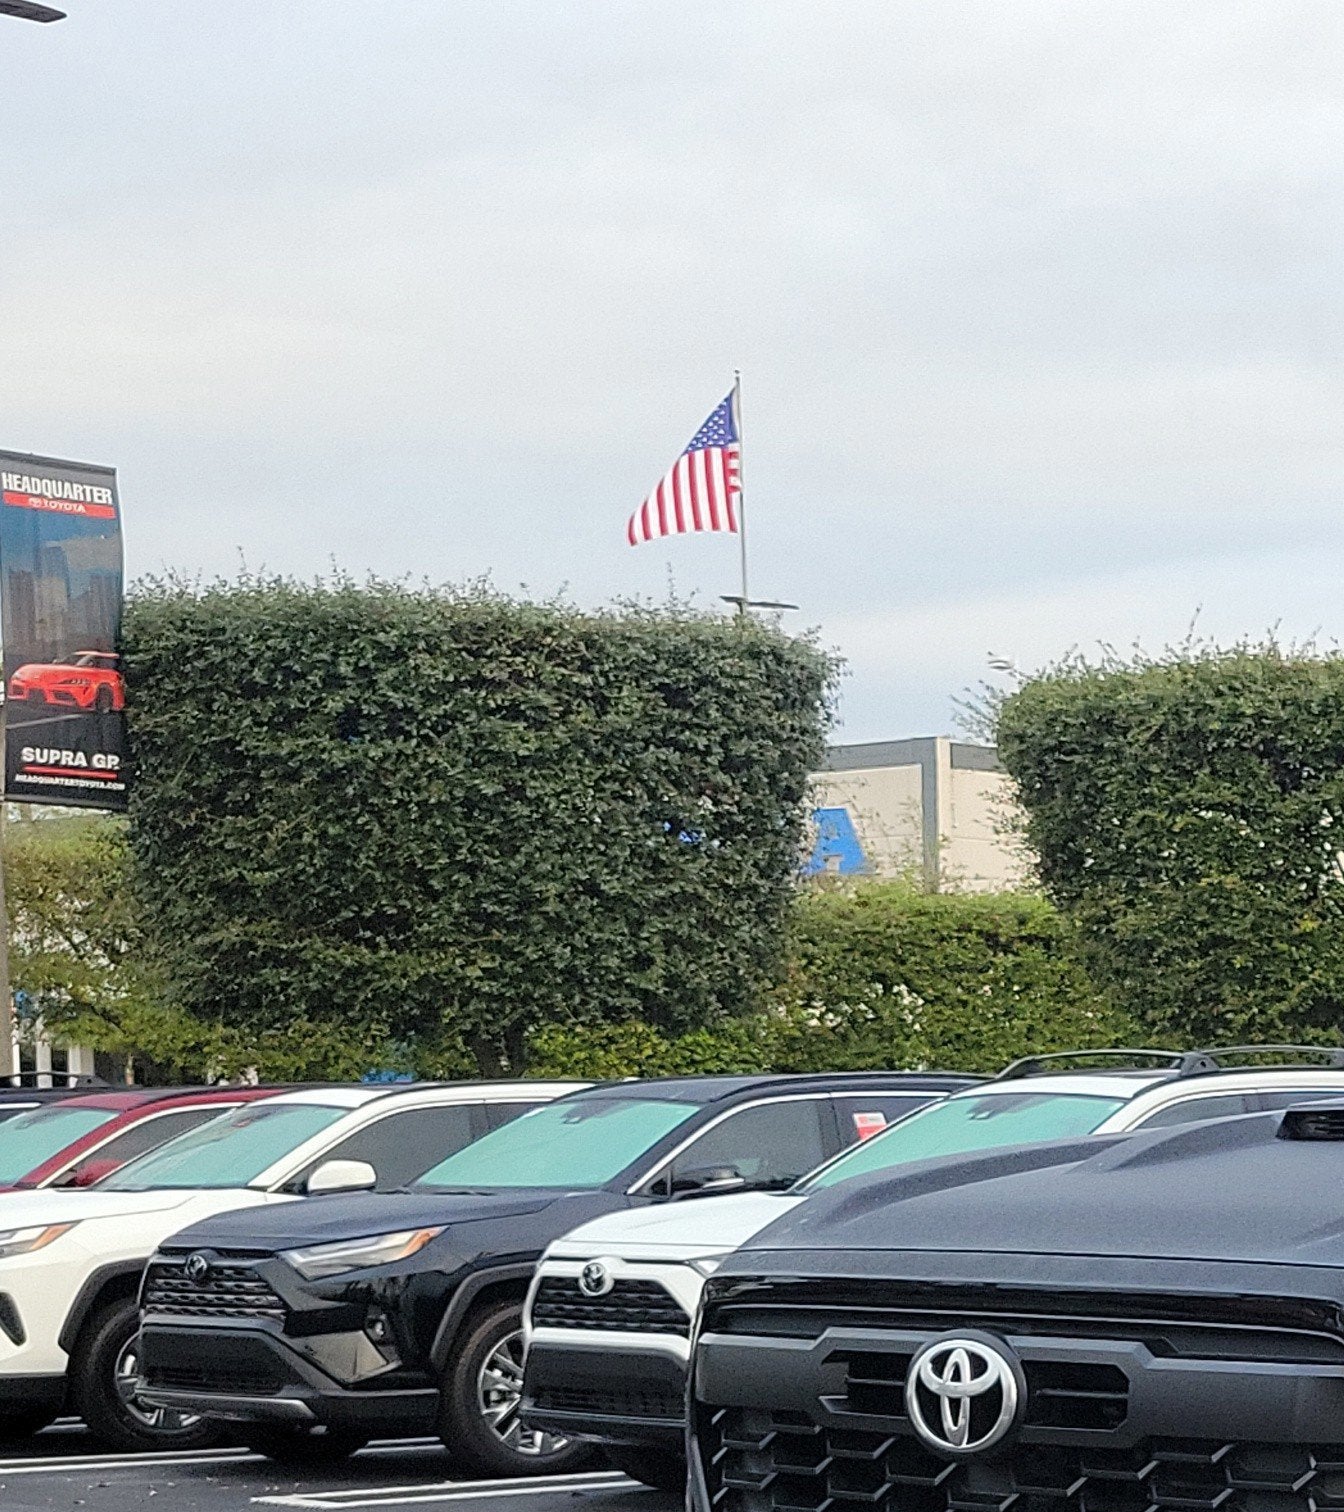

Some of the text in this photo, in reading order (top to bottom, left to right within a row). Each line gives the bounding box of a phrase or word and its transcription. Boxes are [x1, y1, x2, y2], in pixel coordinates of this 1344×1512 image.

[2, 472, 113, 504] HEADQUARTER
[44, 499, 87, 514] TOYOTA
[22, 746, 88, 767] SUPRA
